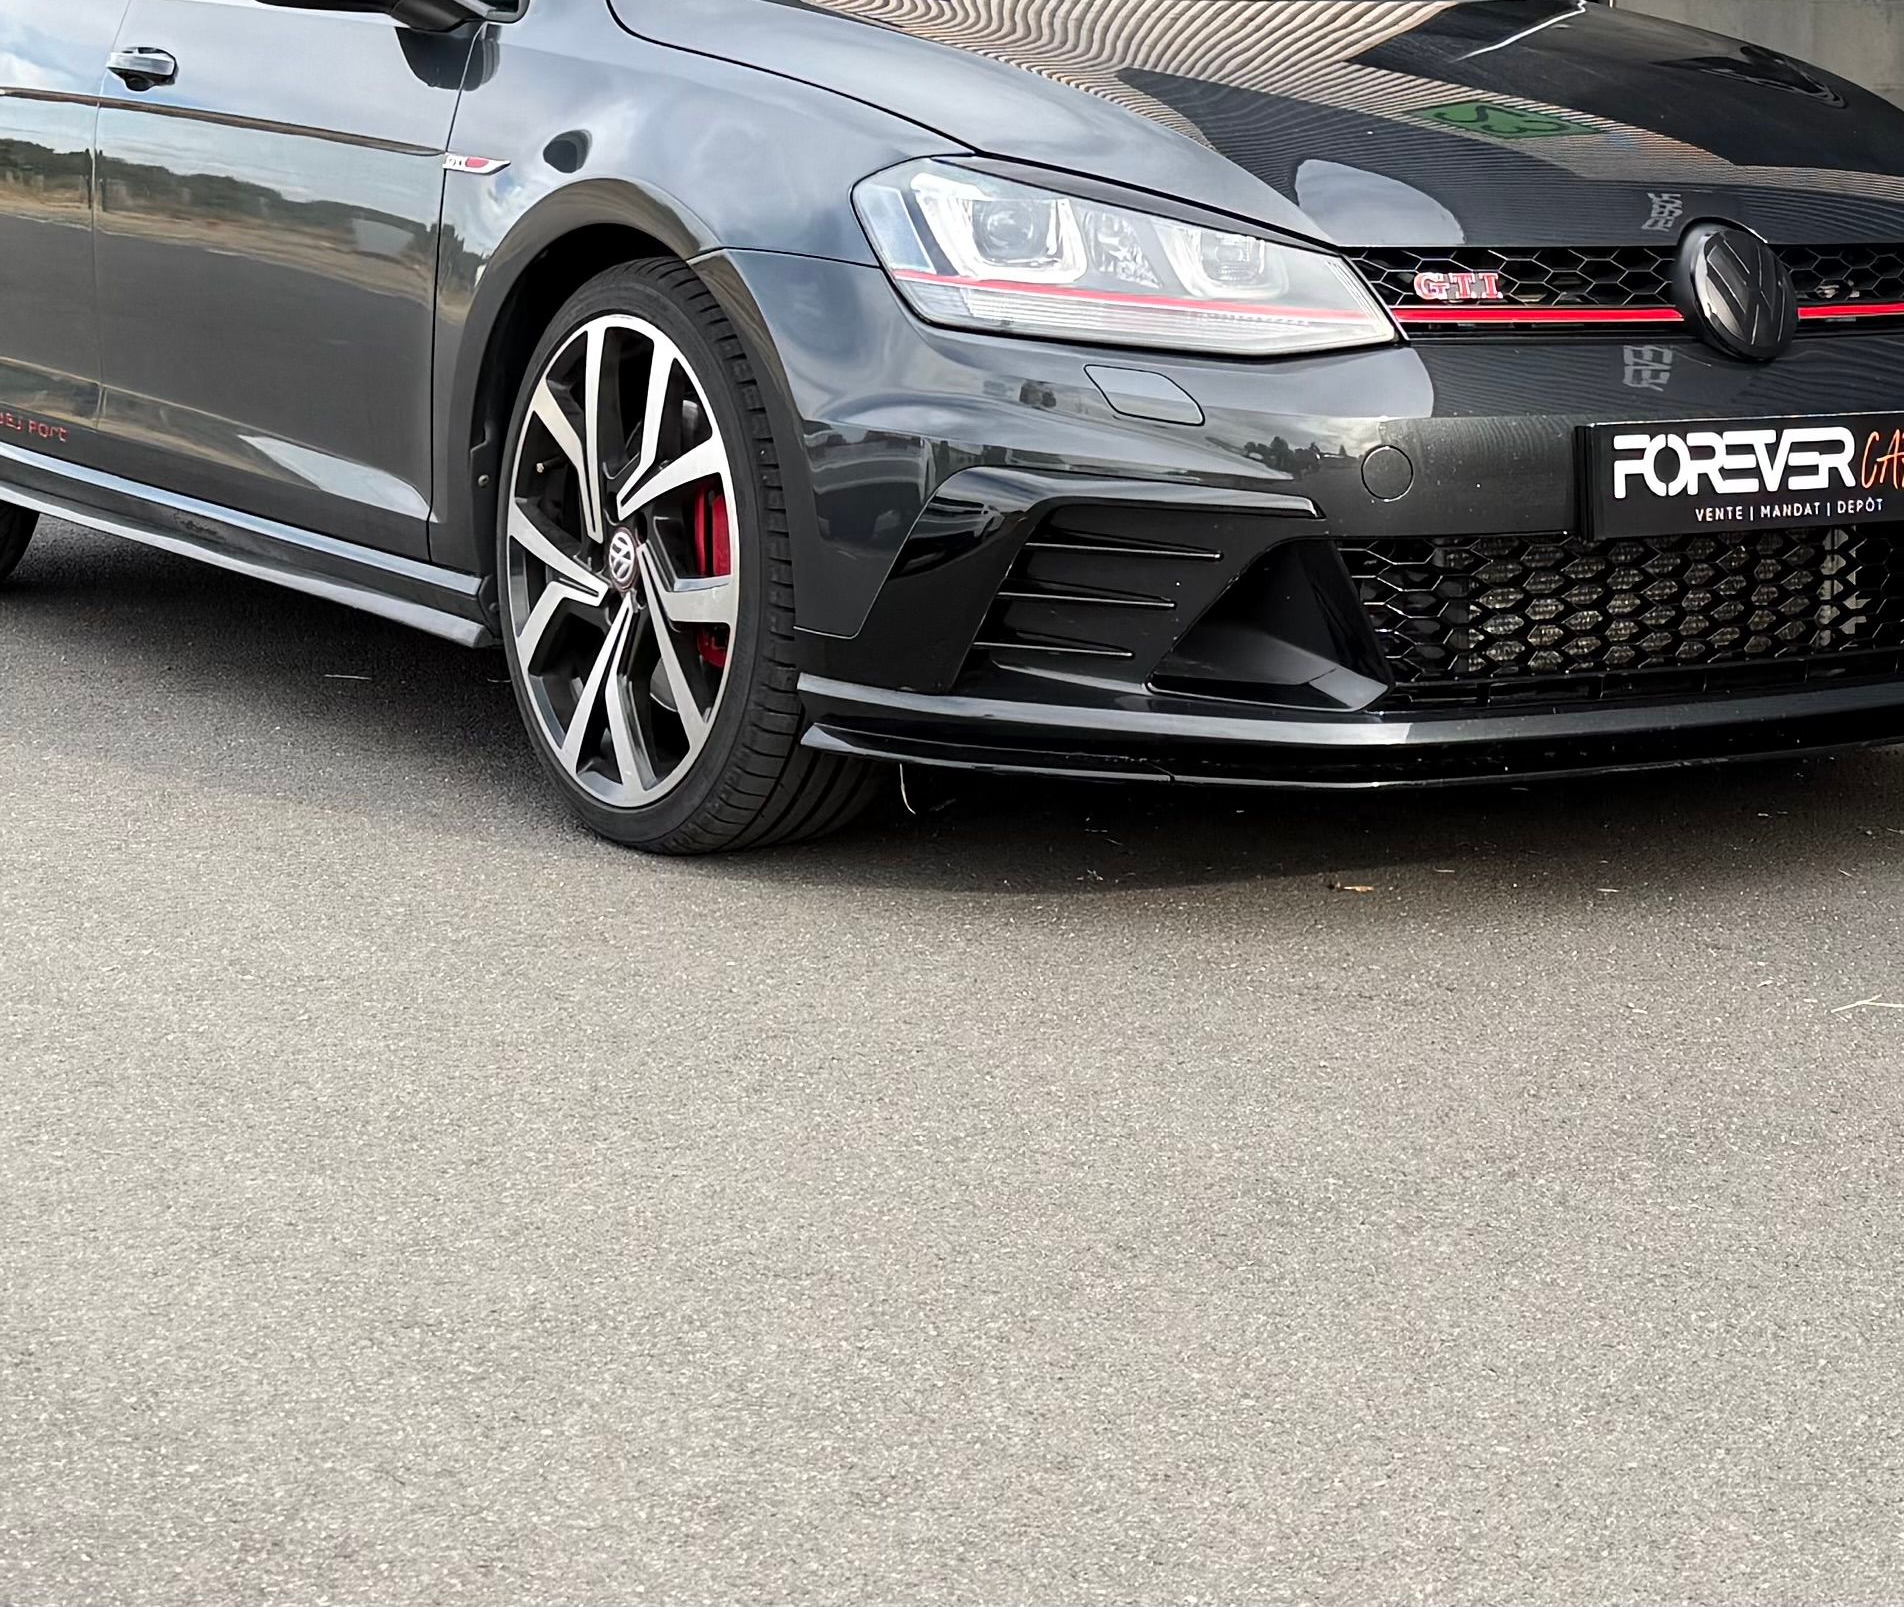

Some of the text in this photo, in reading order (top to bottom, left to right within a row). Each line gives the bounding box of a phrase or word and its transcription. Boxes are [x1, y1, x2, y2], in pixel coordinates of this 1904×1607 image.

[1414, 272, 1504, 300] GTI
[1613, 426, 1856, 499] FOREVER
[1695, 496, 1884, 522] VENTE MANDAT DEPÔT
